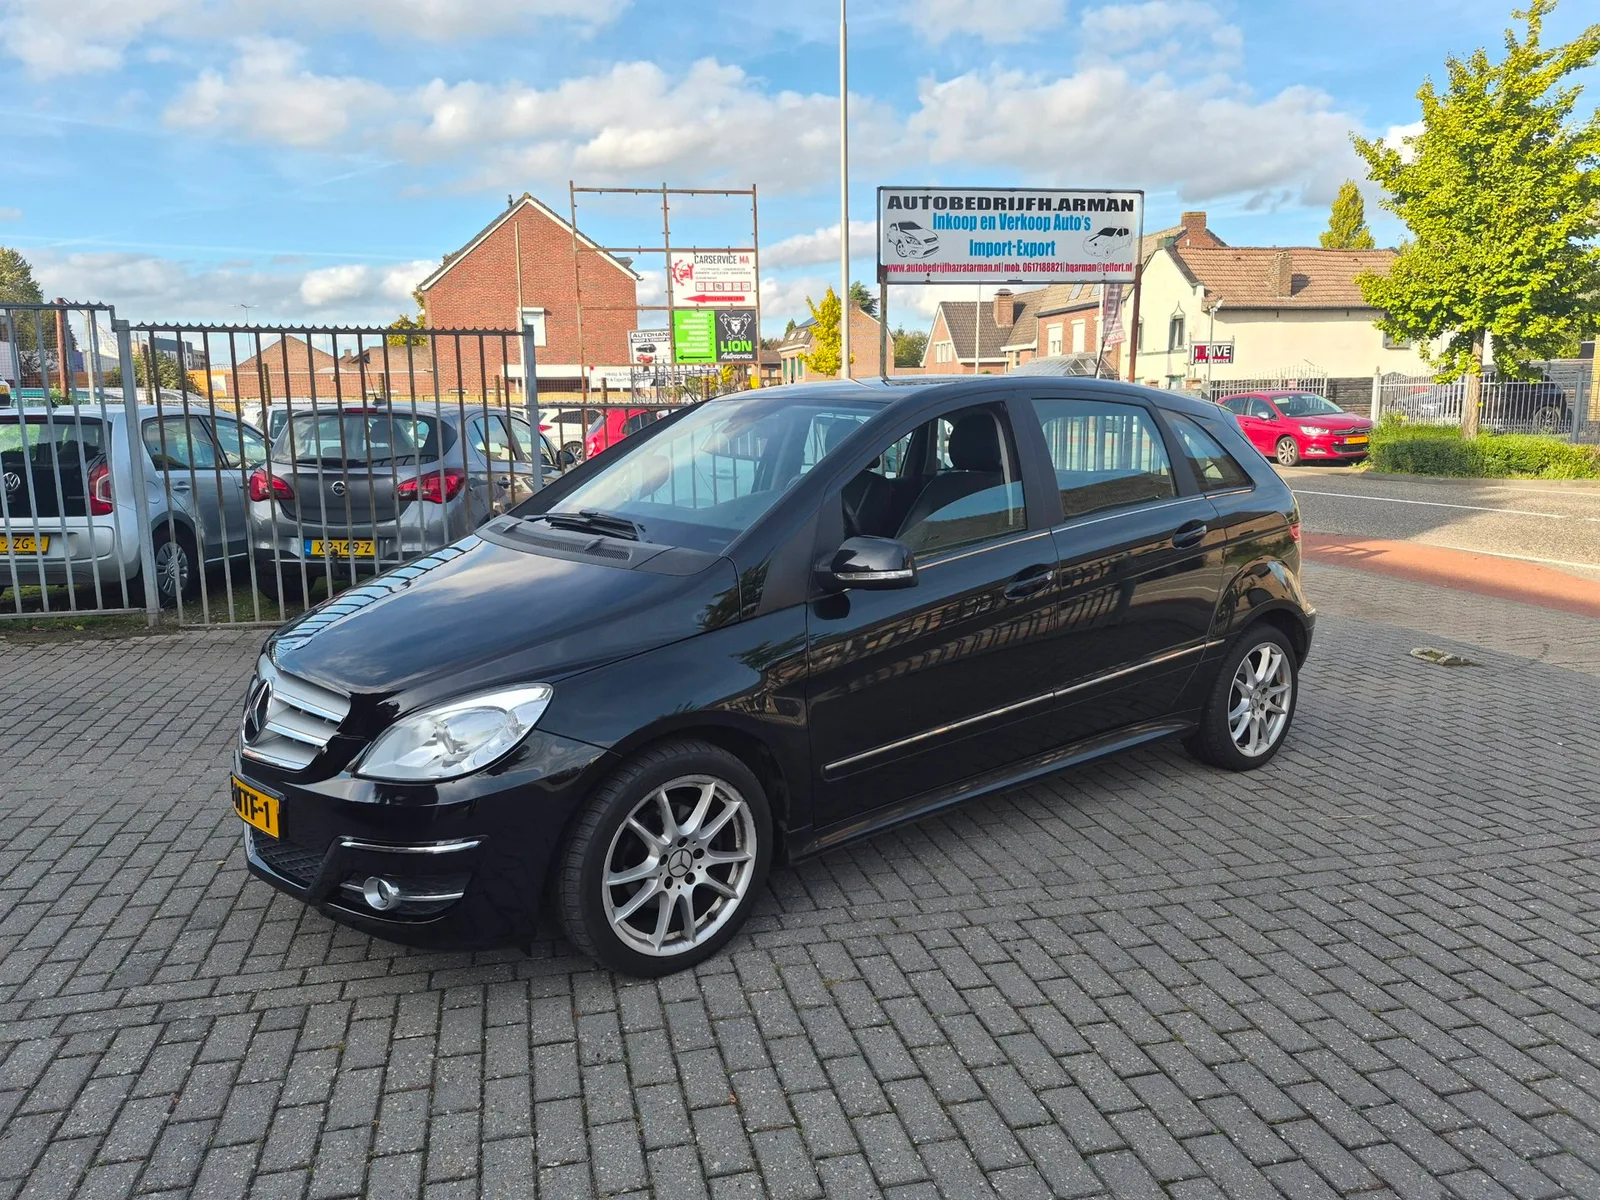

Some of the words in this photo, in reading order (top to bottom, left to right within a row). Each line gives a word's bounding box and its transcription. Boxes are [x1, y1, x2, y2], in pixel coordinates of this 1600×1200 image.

[933, 213, 976, 232] Inkoop
[980, 217, 995, 230] en
[999, 213, 1050, 232] Verkoop
[1053, 214, 1091, 231] Auto's
[969, 239, 1056, 258] Import-Export
[694, 255, 737, 264] CARSERVICE
[739, 256, 750, 264] MA
[1004, 262, 1021, 273] mob.
[720, 341, 753, 352] LION
